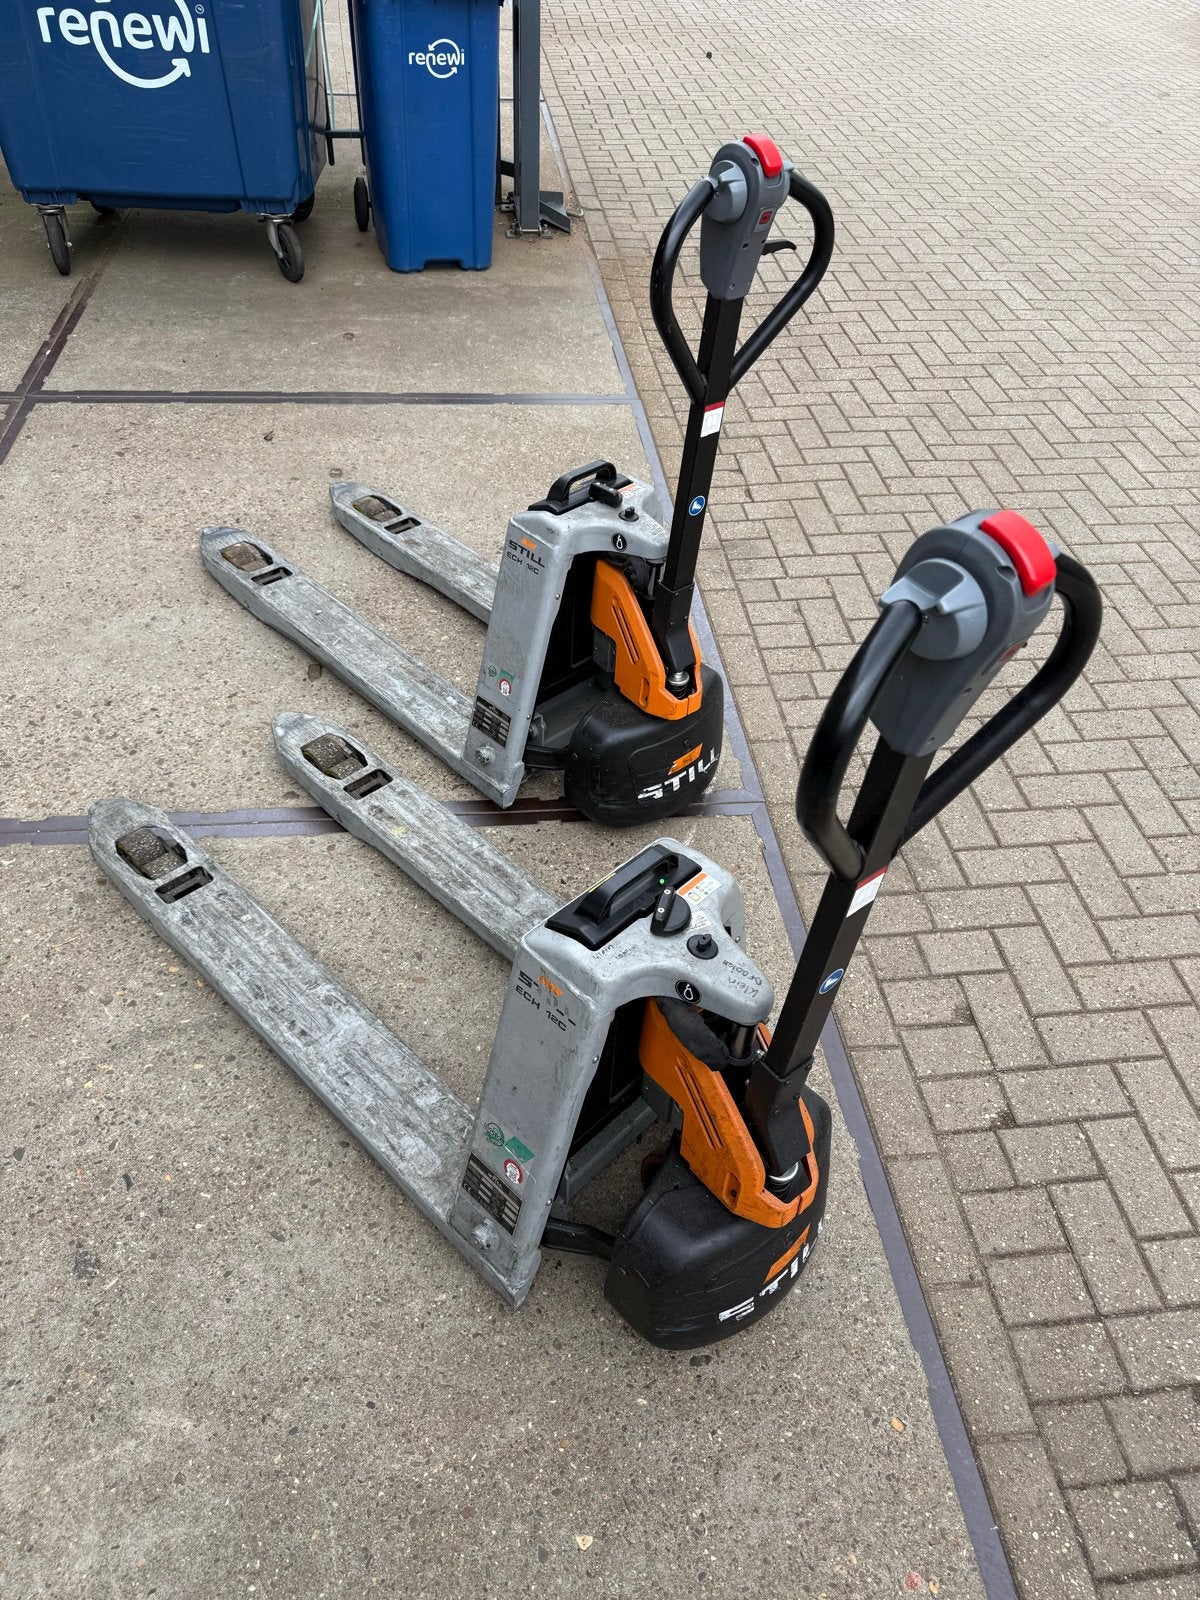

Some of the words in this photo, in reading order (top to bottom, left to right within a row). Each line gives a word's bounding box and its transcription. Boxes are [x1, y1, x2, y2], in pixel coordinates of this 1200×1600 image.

[36, 6, 211, 54] renewi
[408, 51, 465, 66] renewi
[506, 551, 523, 566] ECH
[526, 562, 540, 576] 12C
[509, 539, 545, 569] STILL
[515, 984, 541, 1010] ECH
[545, 1010, 567, 1032] 12C
